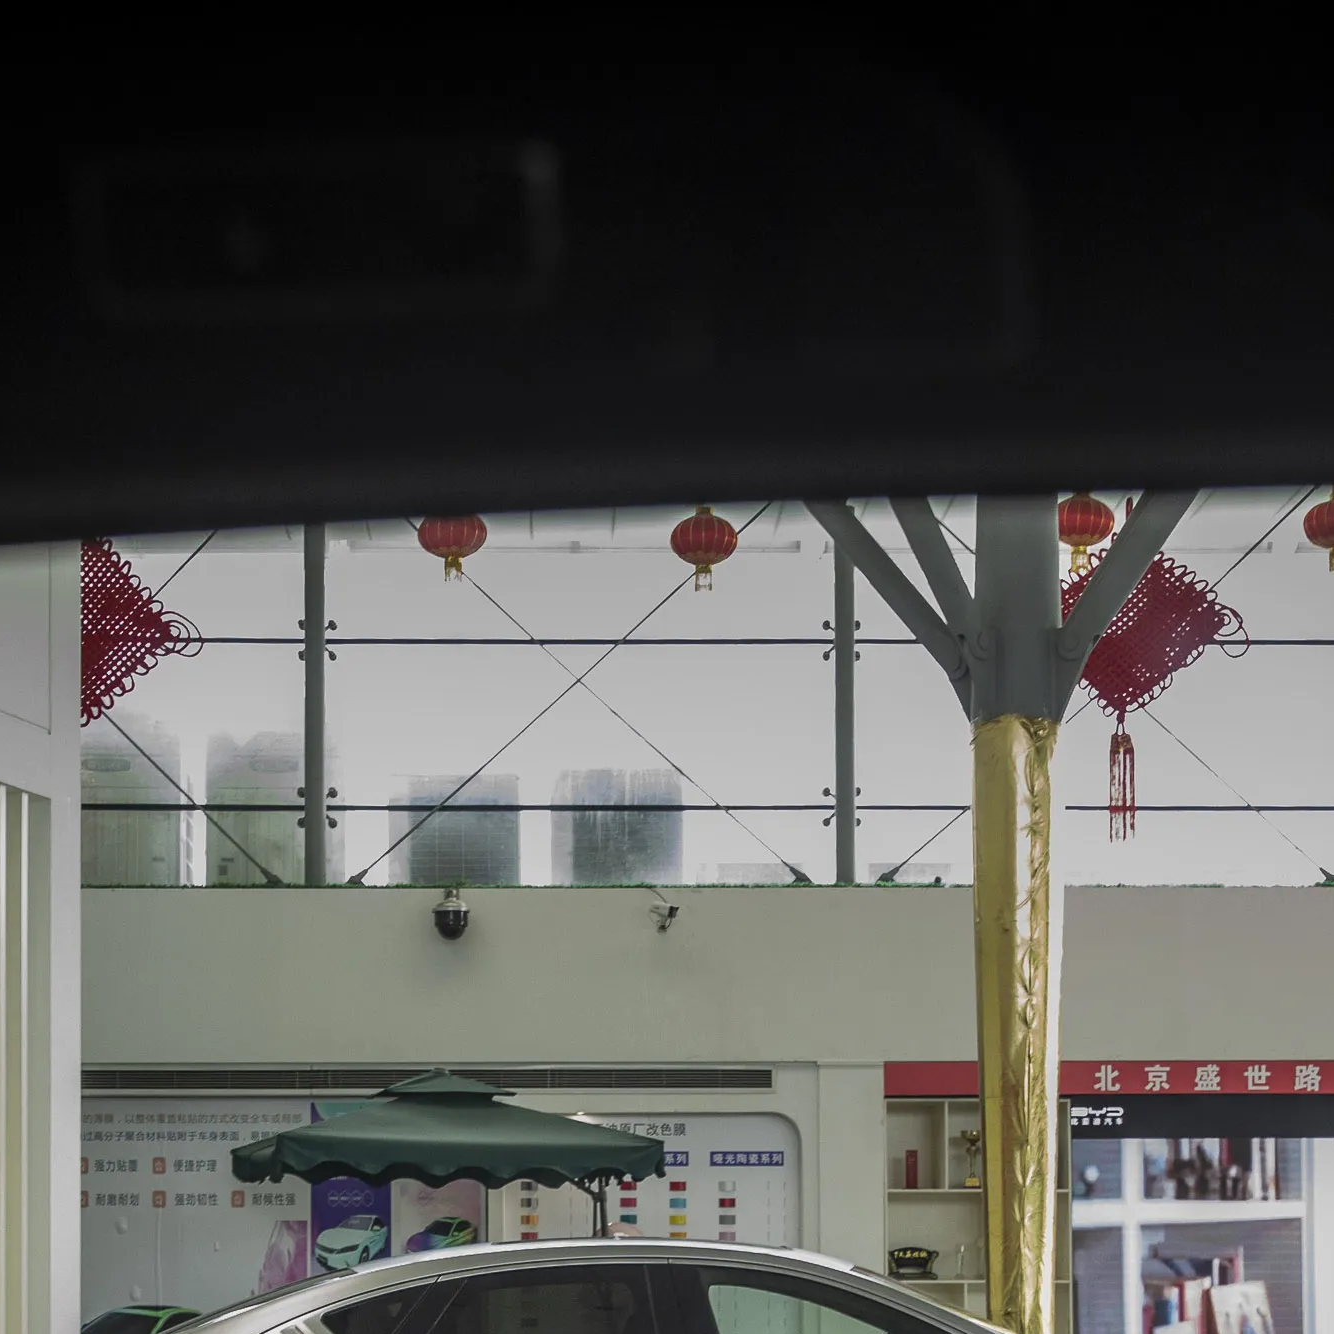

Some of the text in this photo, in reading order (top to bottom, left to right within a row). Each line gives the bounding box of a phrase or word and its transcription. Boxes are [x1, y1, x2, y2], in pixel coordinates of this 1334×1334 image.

[1071, 1106, 1124, 1117] BYD
[712, 1153, 783, 1165] 哑光陶瓷系列
[173, 1159, 217, 1172] 便捷护理
[174, 1193, 218, 1206] 强劲韧性
